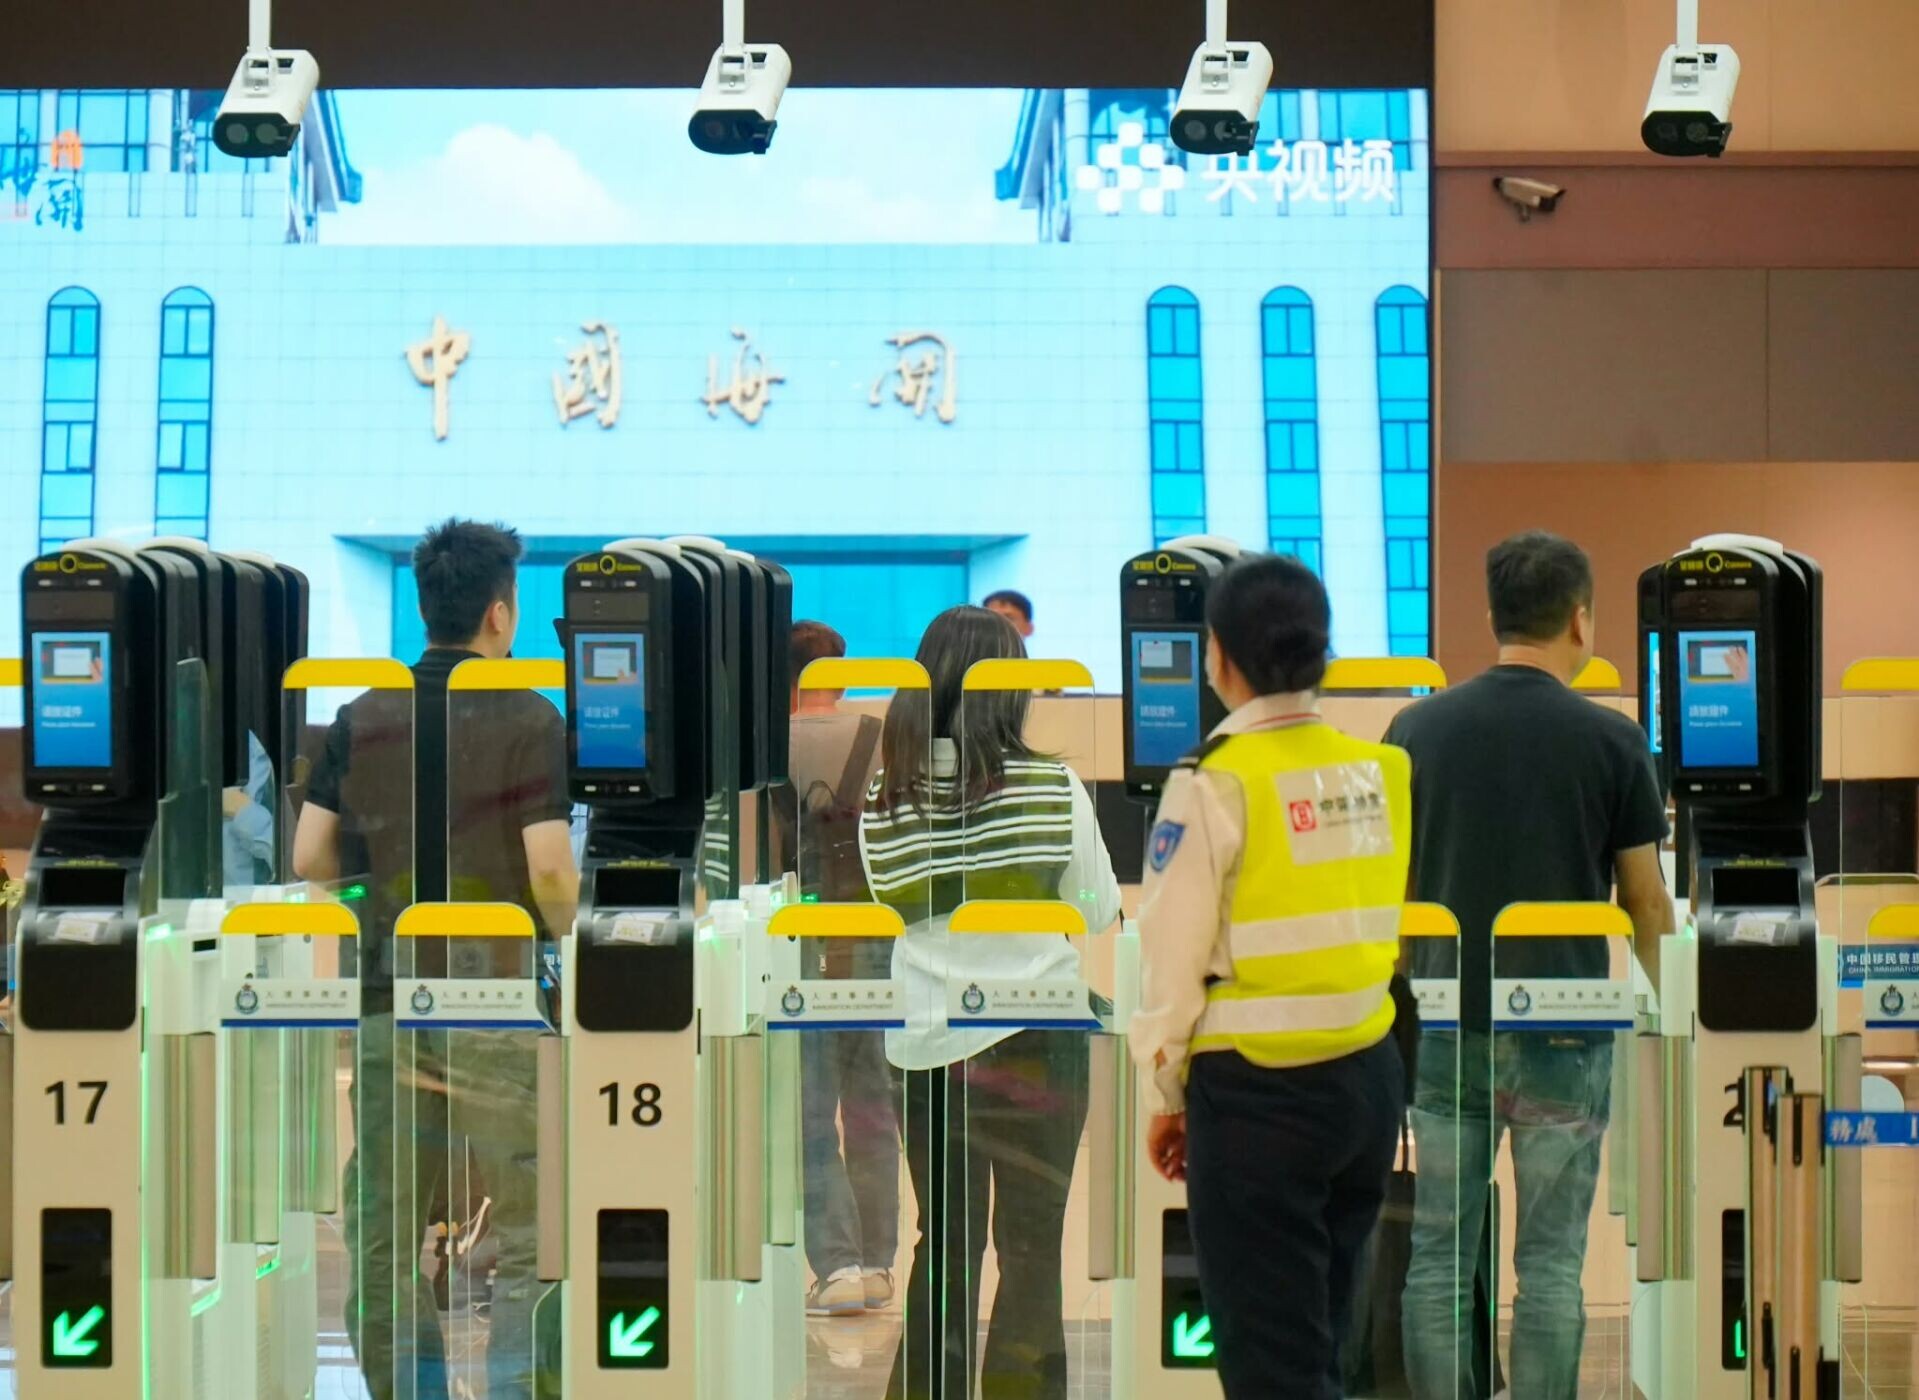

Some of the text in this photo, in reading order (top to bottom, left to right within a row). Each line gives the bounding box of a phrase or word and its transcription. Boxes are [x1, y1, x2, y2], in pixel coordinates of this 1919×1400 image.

[1203, 139, 1396, 202] 央视频
[45, 1081, 108, 1124] 17
[599, 1082, 662, 1126] 18
